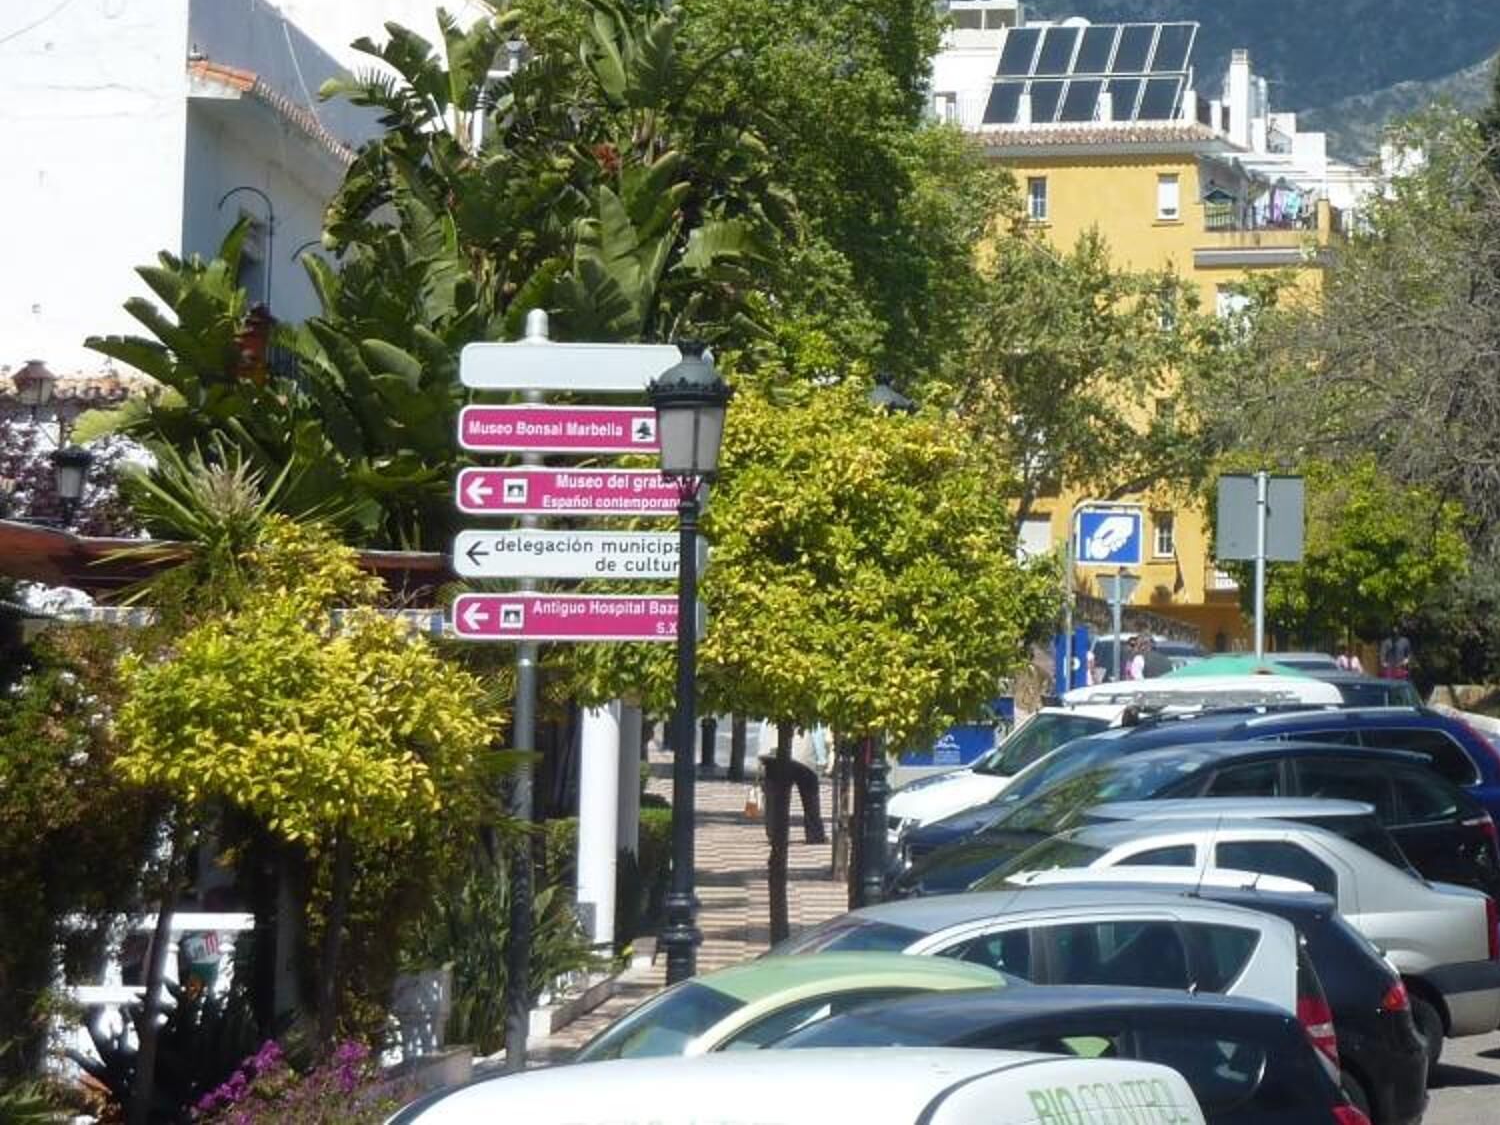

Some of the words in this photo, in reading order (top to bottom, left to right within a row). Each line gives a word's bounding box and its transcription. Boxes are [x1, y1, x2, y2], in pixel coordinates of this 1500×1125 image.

[468, 420, 513, 435] Museo
[515, 420, 563, 436] Bonsai
[566, 421, 624, 437] Marbella
[555, 474, 603, 489] Museo
[607, 474, 629, 489] del
[542, 494, 593, 510] Español
[595, 495, 681, 512] contemporan
[494, 537, 594, 556] delegación
[601, 537, 681, 556] municipa
[594, 557, 617, 572] de
[624, 557, 680, 572] cultur
[532, 600, 586, 618] Antiguo
[589, 600, 645, 617] Hospital
[649, 601, 679, 615] Baz
